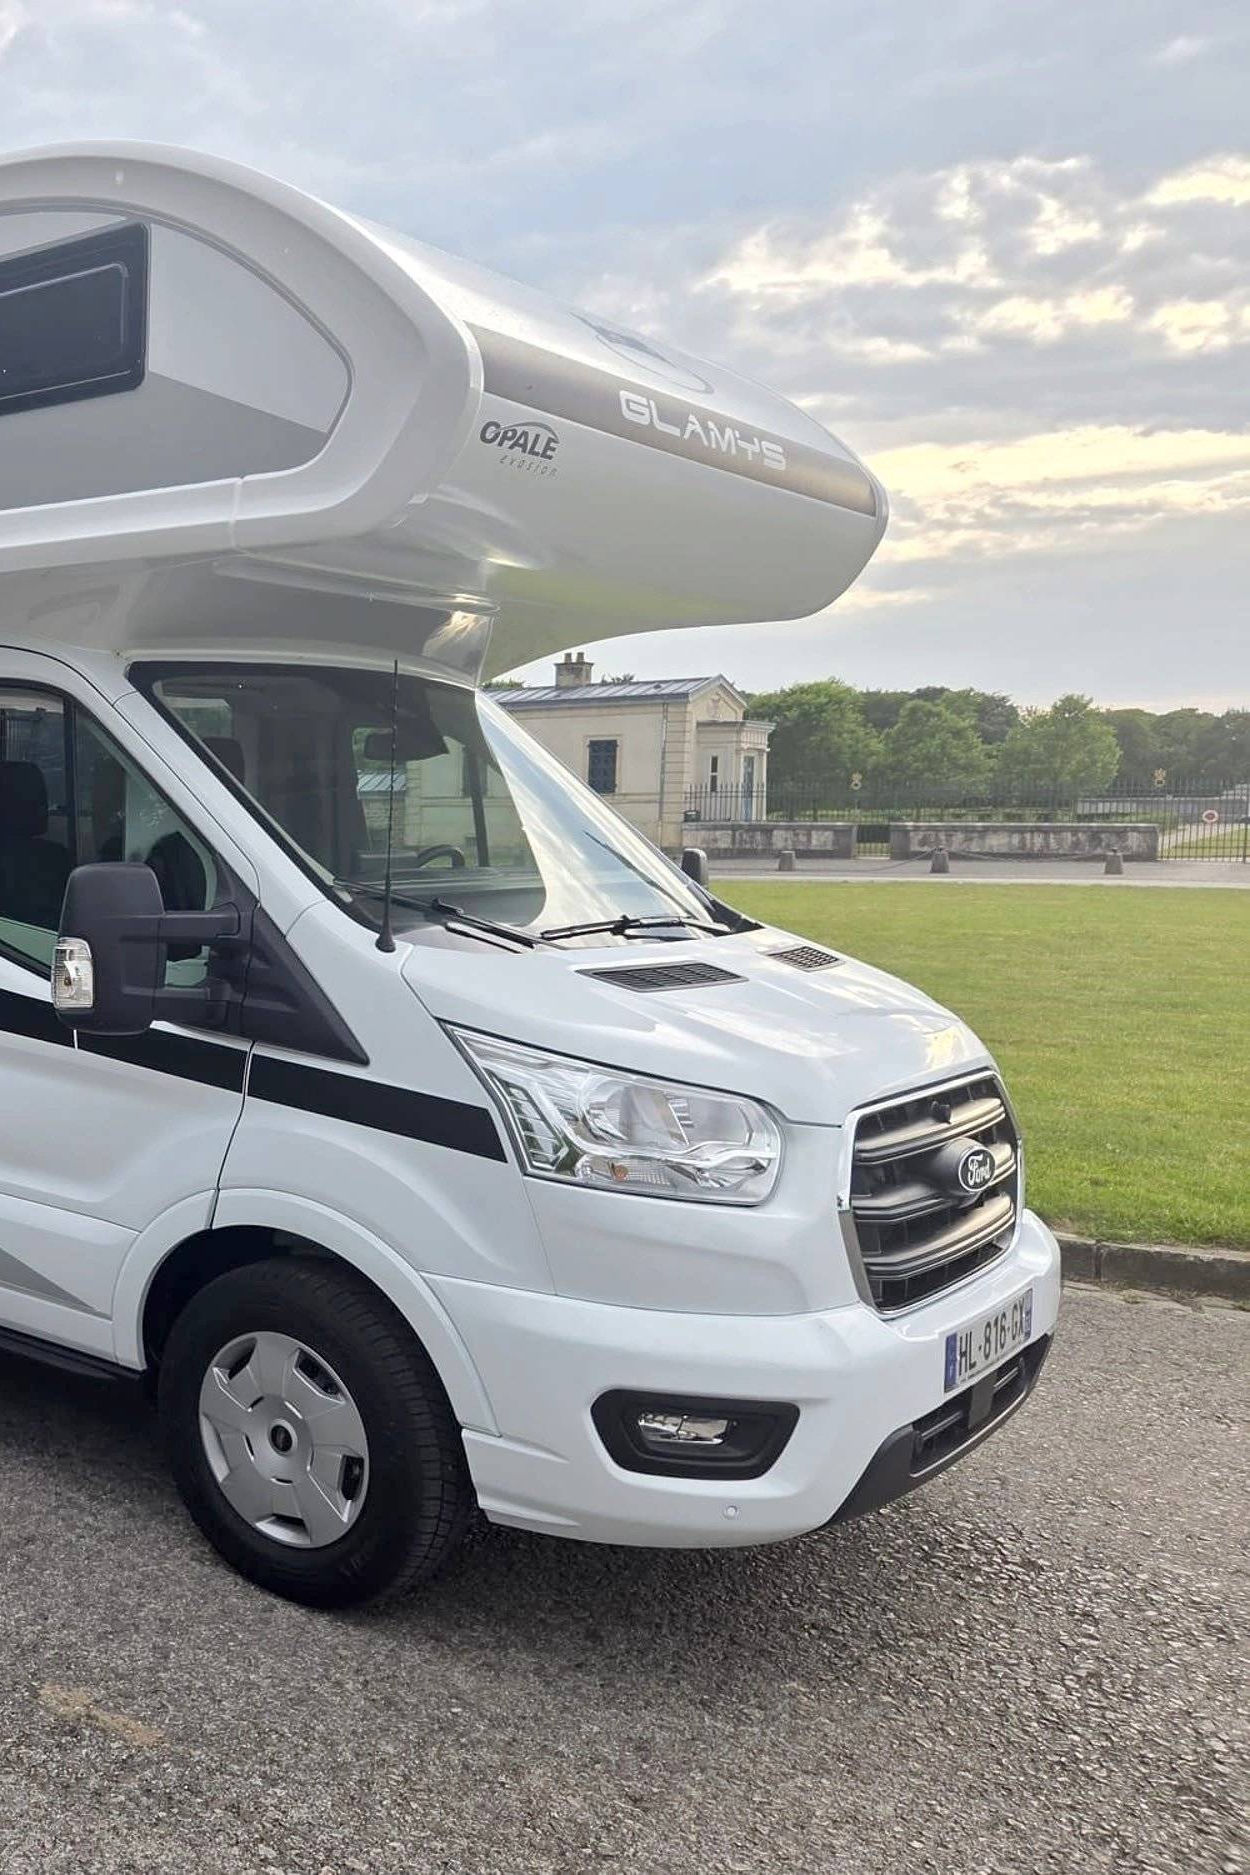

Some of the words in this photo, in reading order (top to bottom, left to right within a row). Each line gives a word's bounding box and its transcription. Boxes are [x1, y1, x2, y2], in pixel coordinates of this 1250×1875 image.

[480, 421, 559, 460] OPALE
[619, 389, 787, 471] GLAMYS
[968, 1154, 991, 1186] Ford
